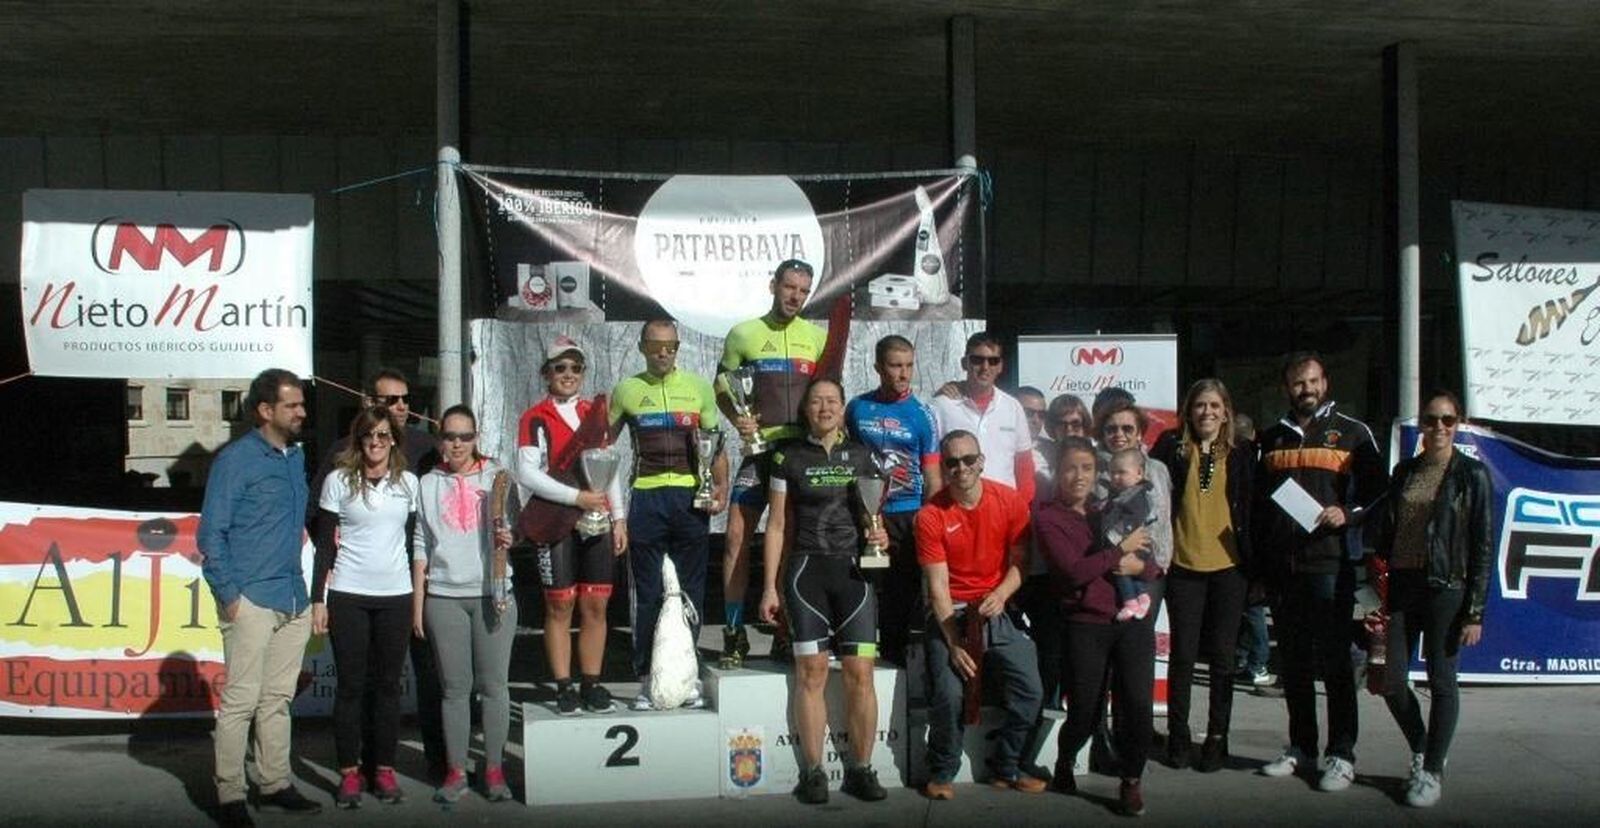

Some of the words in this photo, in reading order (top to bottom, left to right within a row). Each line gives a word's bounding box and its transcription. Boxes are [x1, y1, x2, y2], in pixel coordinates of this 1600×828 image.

[655, 232, 807, 262] PATABRAVA
[1472, 252, 1579, 286] Salones
[30, 281, 149, 329] Nieto
[154, 283, 308, 332] Martín
[63, 341, 142, 353] PRODUCTOS
[209, 341, 274, 353] GUIJUELO
[1049, 374, 1092, 392] Nieto
[1500, 657, 1541, 671] Ctra.
[604, 724, 641, 768] 2
